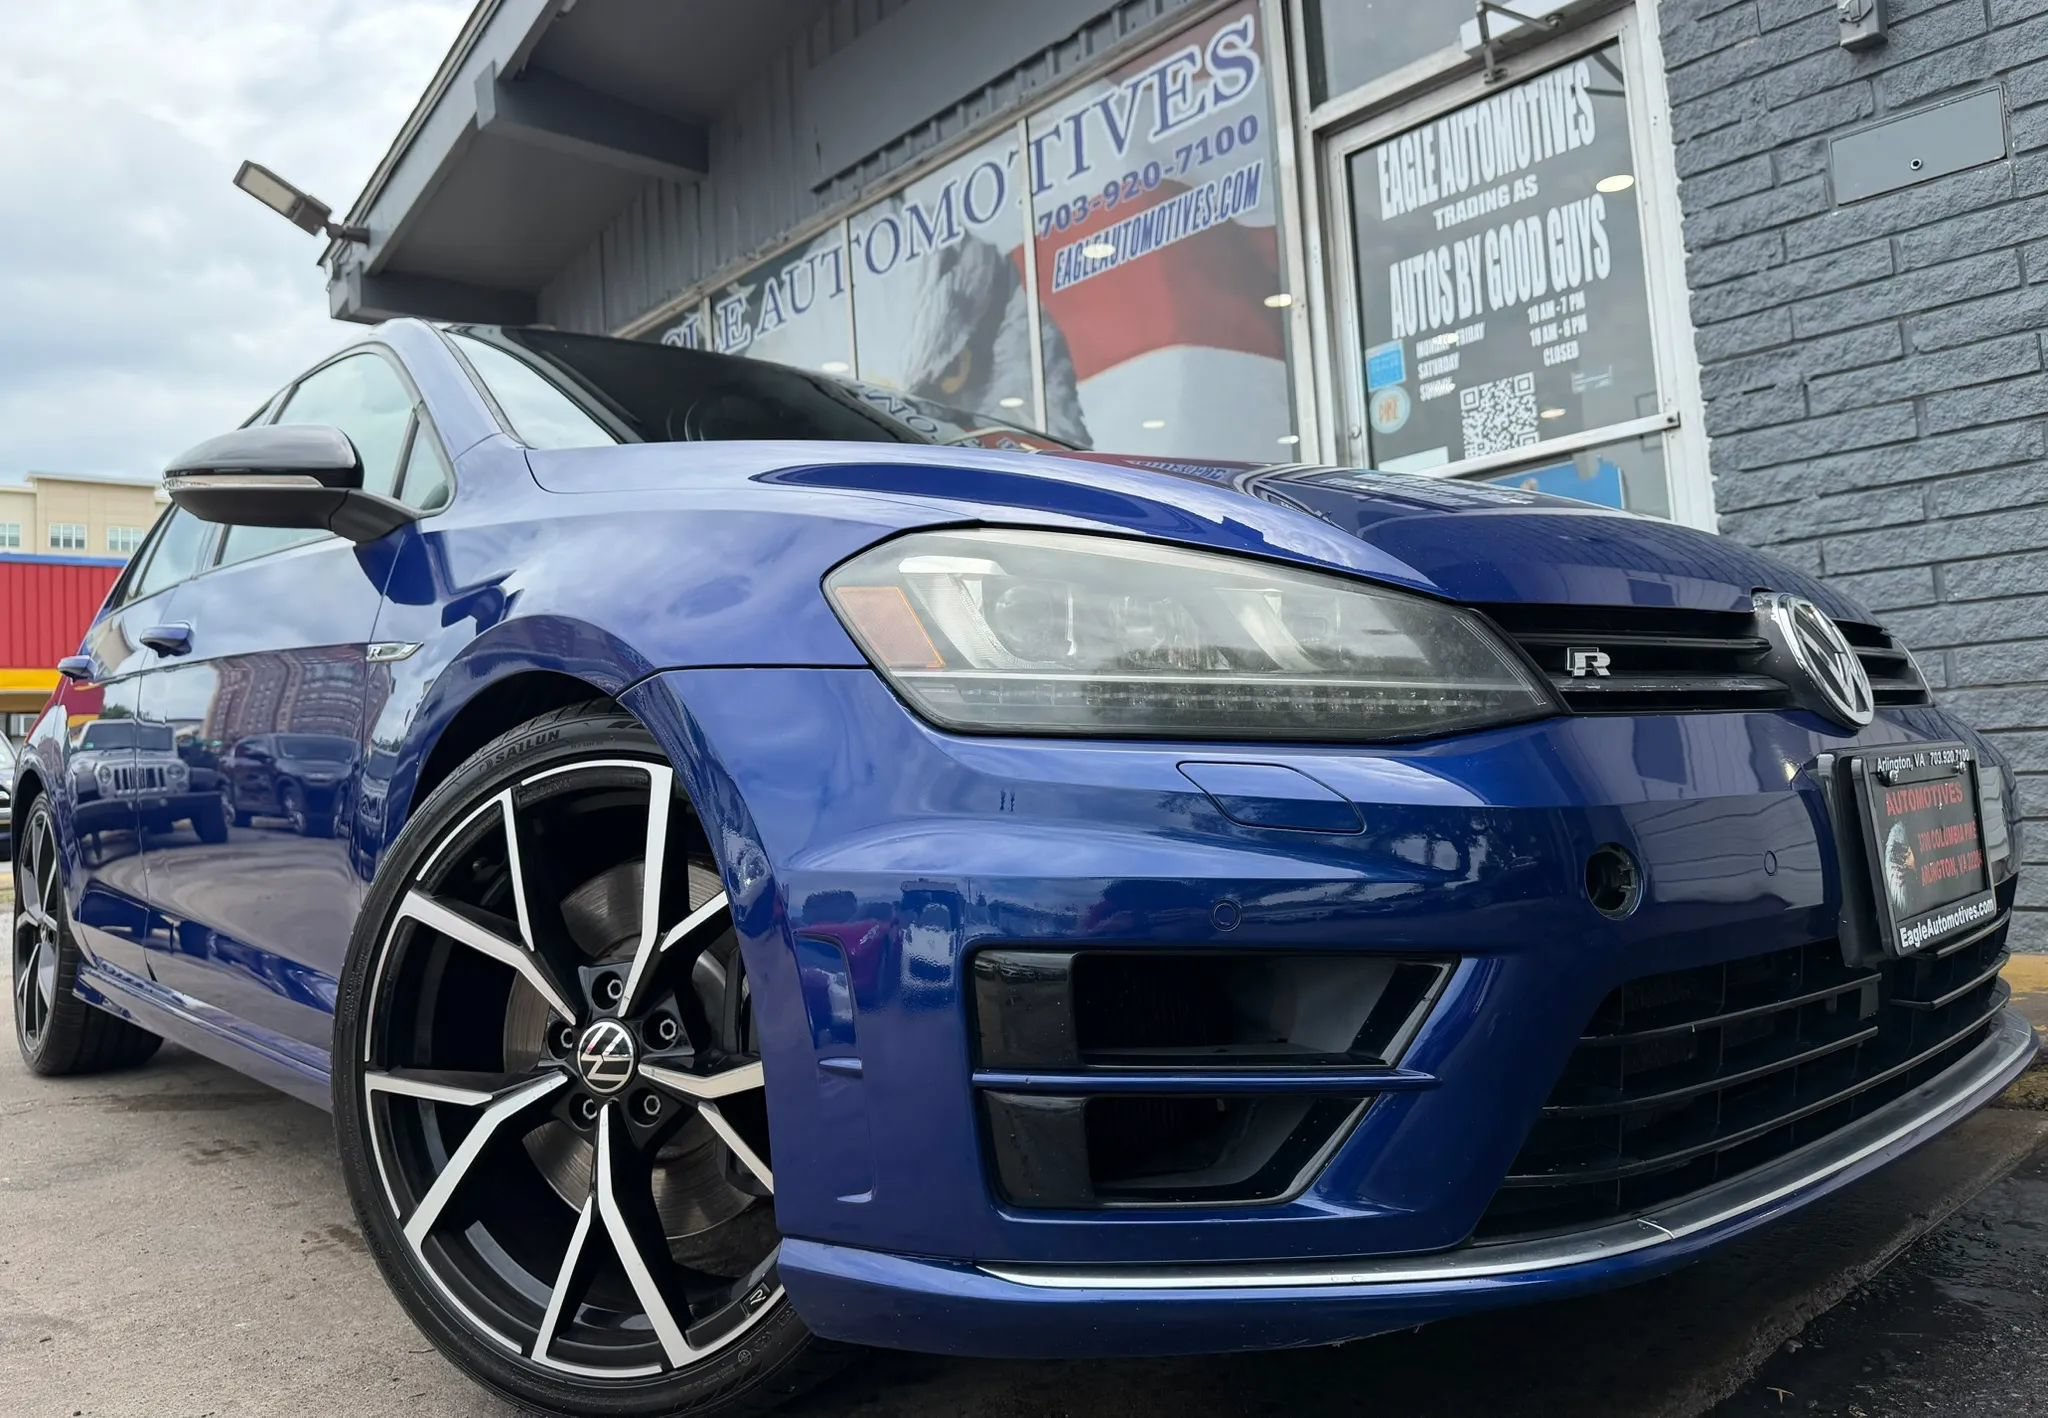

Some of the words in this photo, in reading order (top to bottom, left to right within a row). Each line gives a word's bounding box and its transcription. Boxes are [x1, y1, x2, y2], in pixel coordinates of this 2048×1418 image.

[1377, 123, 1439, 221] EAGLE
[1438, 61, 1596, 198] AUTOMOTIVES
[754, 13, 1258, 340] AUTOMOTIVES
[1038, 113, 1259, 239] 703-920-7100
[1433, 184, 1510, 231] TRADING
[1513, 173, 1539, 203] AS
[1054, 161, 1262, 292] EAGLEAUTOMOTIVES.COM
[1390, 245, 1455, 339] AUTOS
[1454, 234, 1483, 320] BY
[1485, 215, 1547, 311] GOOD
[1547, 193, 1611, 293] GUYS
[1528, 304, 1540, 324] 10
[1540, 299, 1556, 321] AM
[1569, 290, 1586, 312] PM
[1529, 326, 1542, 347] 10
[1542, 322, 1558, 344] AM
[1571, 313, 1588, 335] PM
[1417, 351, 1459, 380] SATURDAY
[1543, 340, 1579, 367] CLOSED
[495, 729, 561, 762] SAILUN
[1877, 756, 1913, 772] Arlington,
[1914, 752, 1926, 767] VA
[1886, 782, 1963, 816] AUTOMOTIVES
[1900, 898, 1994, 948] EagleAutomotives.com
